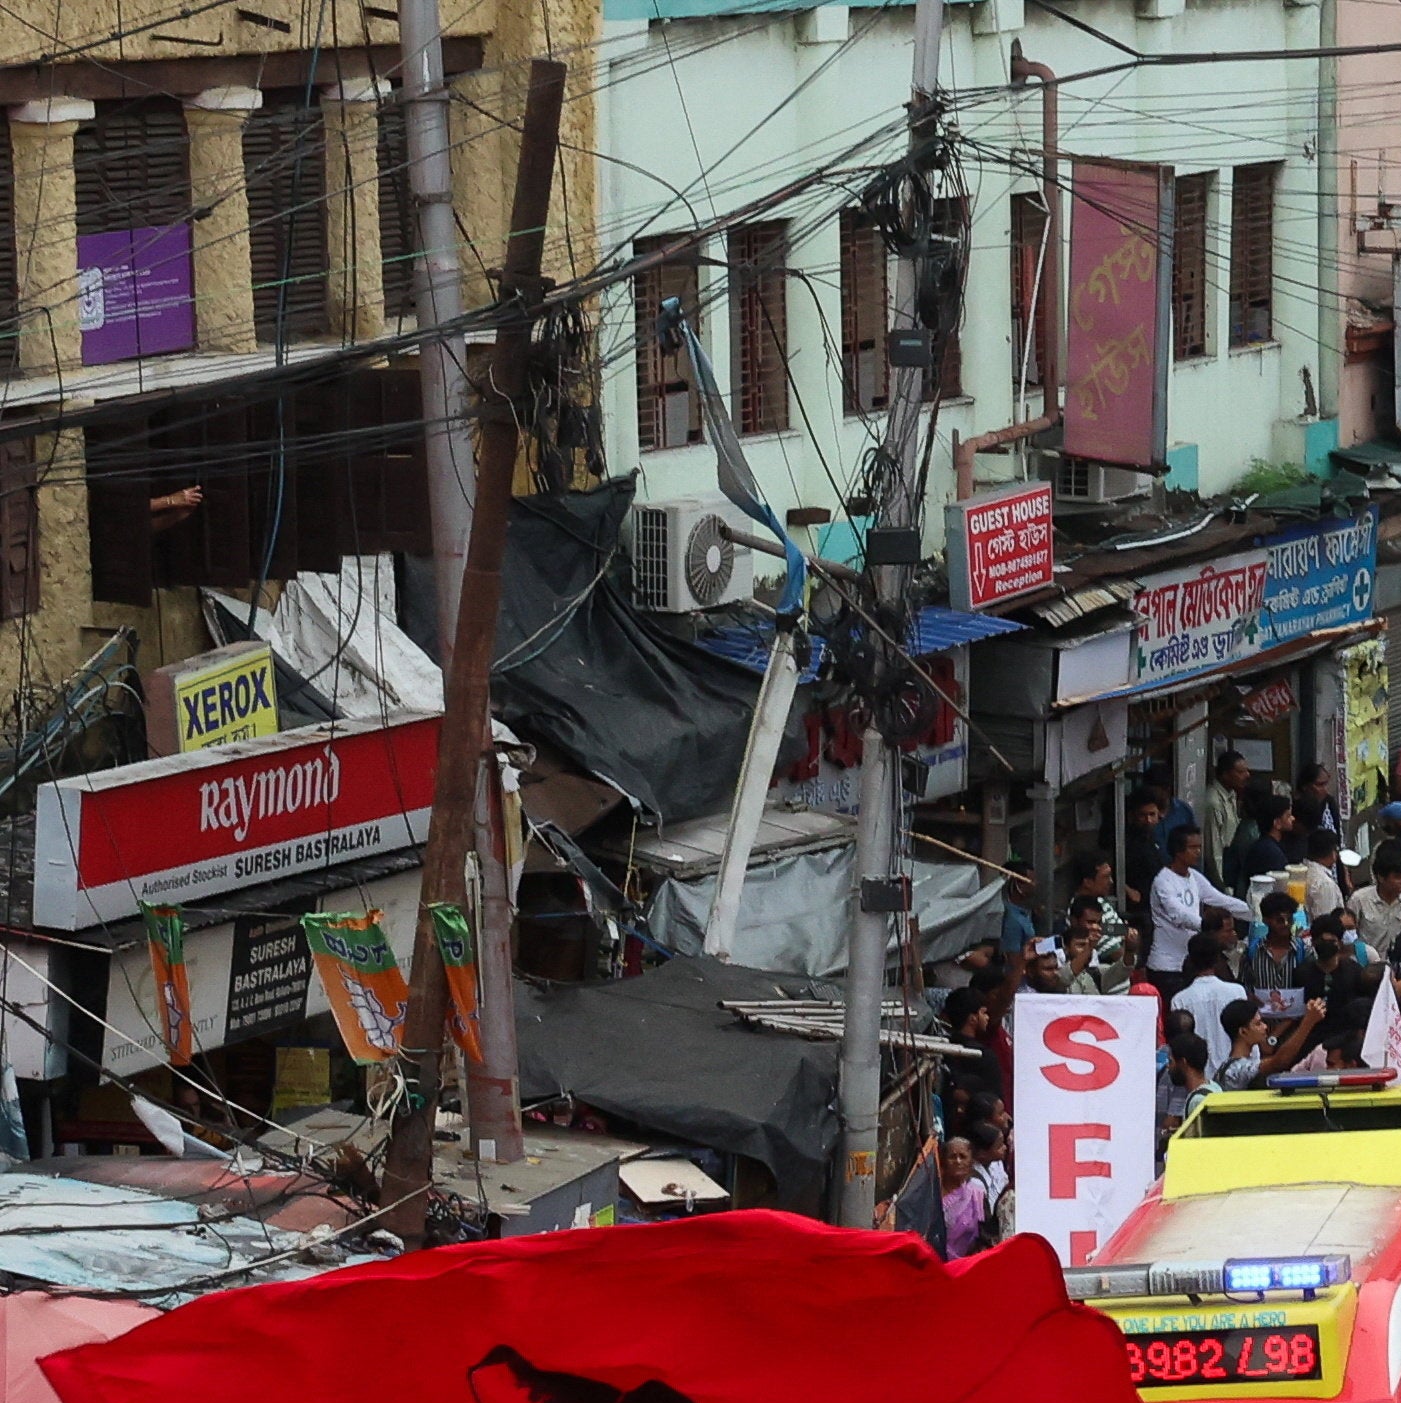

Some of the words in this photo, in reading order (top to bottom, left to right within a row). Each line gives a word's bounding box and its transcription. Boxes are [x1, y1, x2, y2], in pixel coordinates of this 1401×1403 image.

[1075, 225, 1155, 331] গেস্ট
[970, 504, 1009, 535] GUEST
[1011, 495, 1050, 525] HOUSE
[988, 532, 1015, 559] গেস্ট
[1018, 522, 1049, 551] হাউস
[994, 569, 1043, 594] Reception
[183, 667, 272, 741] XEROX
[199, 745, 341, 843] Raymond
[141, 868, 189, 897] Authorised
[191, 862, 228, 887] Stockist
[234, 846, 292, 879] SURESH
[296, 825, 382, 865] BASTRALAYA
[247, 936, 296, 965] SURESH
[233, 959, 306, 993] BASTRALAYA
[1211, 1313, 1236, 1331] ARE
[1251, 1311, 1286, 1329] HERO
